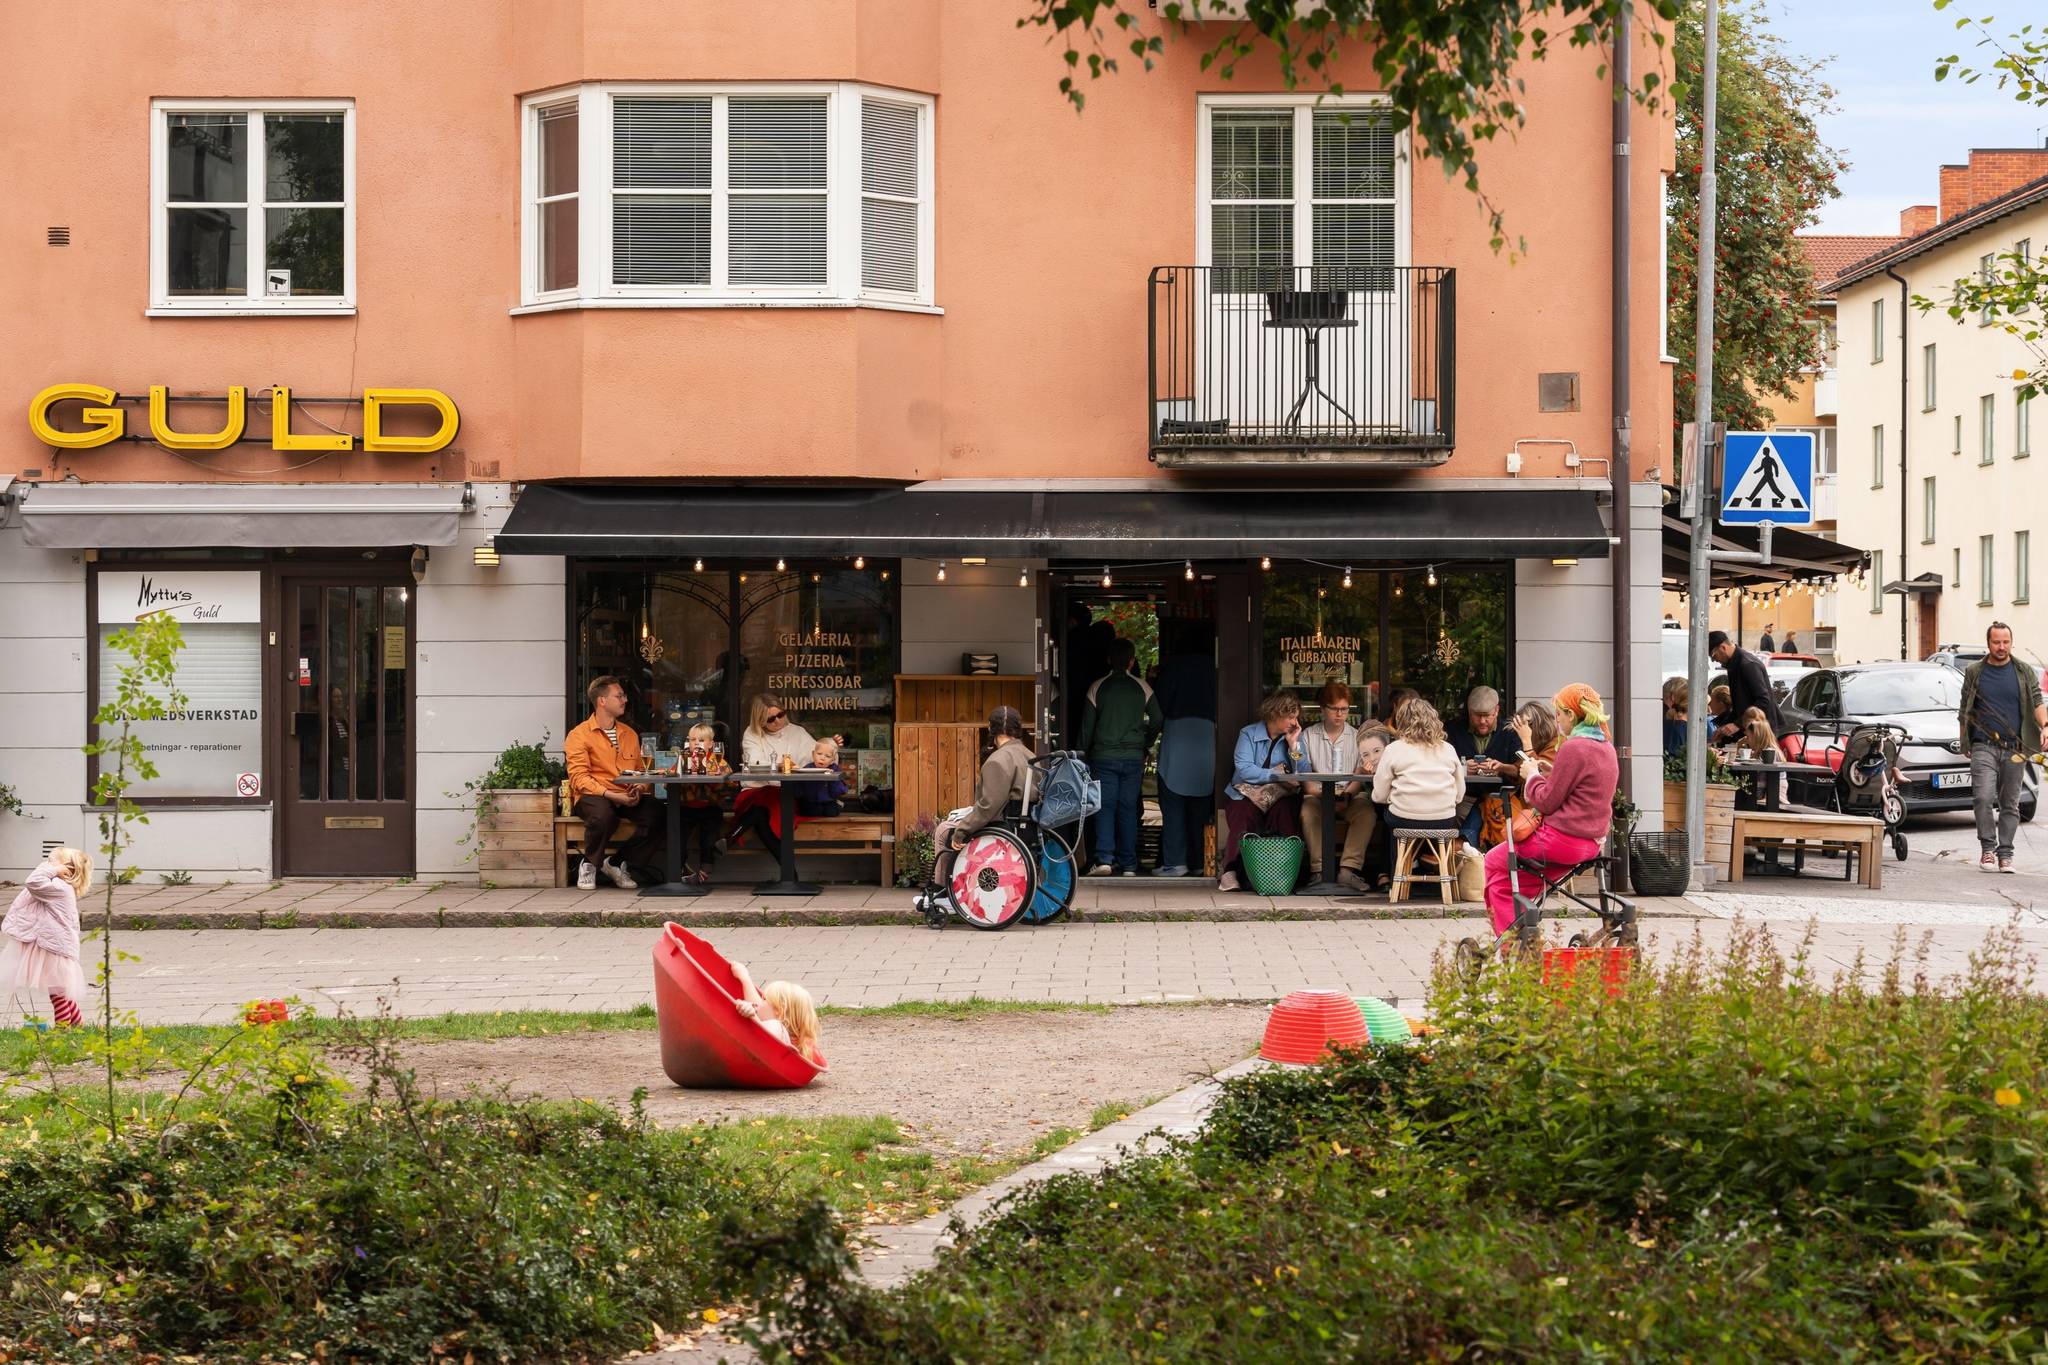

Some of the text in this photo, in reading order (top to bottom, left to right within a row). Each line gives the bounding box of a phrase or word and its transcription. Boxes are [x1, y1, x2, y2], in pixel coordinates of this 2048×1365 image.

[28, 382, 460, 453] GULD
[193, 604, 222, 619] Guld
[779, 632, 852, 647] GELATERIA
[1280, 635, 1361, 651] ITALIENAREN
[785, 654, 845, 668] PIZZERIA
[1291, 650, 1355, 664] GUBBÄNGEN
[768, 675, 862, 689] ESPRESSOBAR
[780, 696, 859, 710] INIMARKET
[103, 709, 258, 721] ULDMEDSVERKSTAD
[189, 743, 242, 752] reparationer
[1942, 774, 1963, 785] YJA
